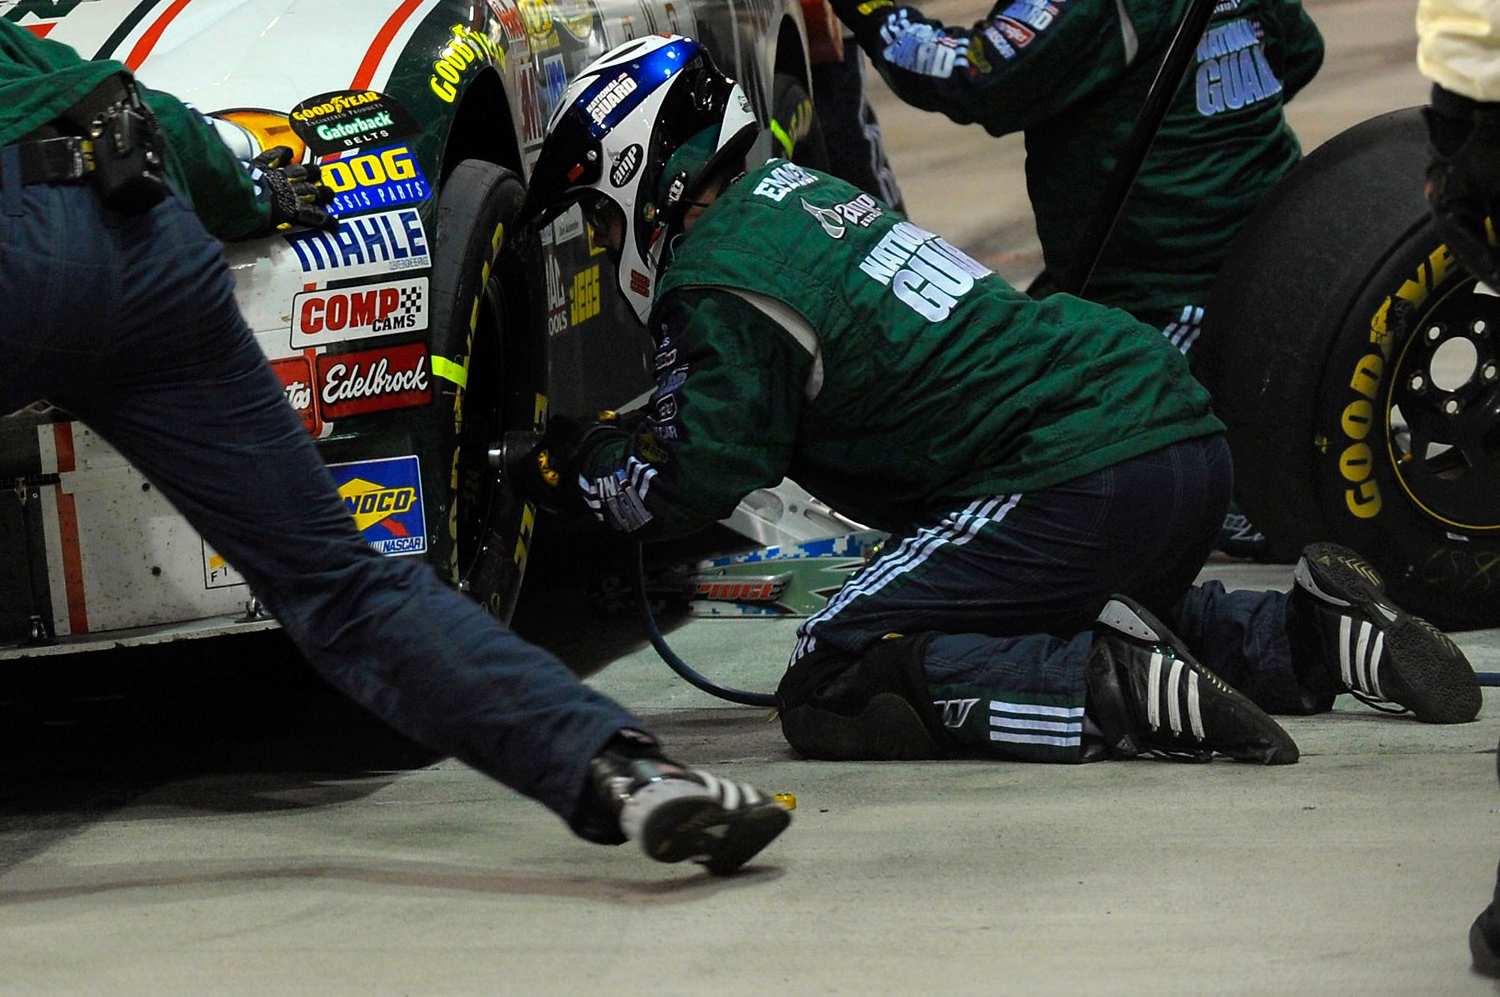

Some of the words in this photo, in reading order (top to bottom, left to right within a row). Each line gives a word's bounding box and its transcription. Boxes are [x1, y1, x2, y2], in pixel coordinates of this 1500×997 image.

[291, 90, 381, 121] GOODYEAR
[585, 78, 622, 114] NATIONAL
[590, 76, 638, 124] GUARD
[315, 111, 395, 142] Gatorback
[343, 129, 390, 147] BELTS
[320, 147, 417, 193] OOG
[612, 145, 638, 186] amp
[327, 191, 371, 214] ASSIS
[377, 182, 424, 203] PARTS
[283, 211, 428, 273] MAHLE
[300, 287, 399, 335] COMP
[371, 314, 417, 332] CAMS
[548, 310, 568, 336] OOLS
[322, 356, 429, 404] Edelbrock
[343, 490, 412, 516] NOCO
[383, 537, 422, 552] NASCAR
